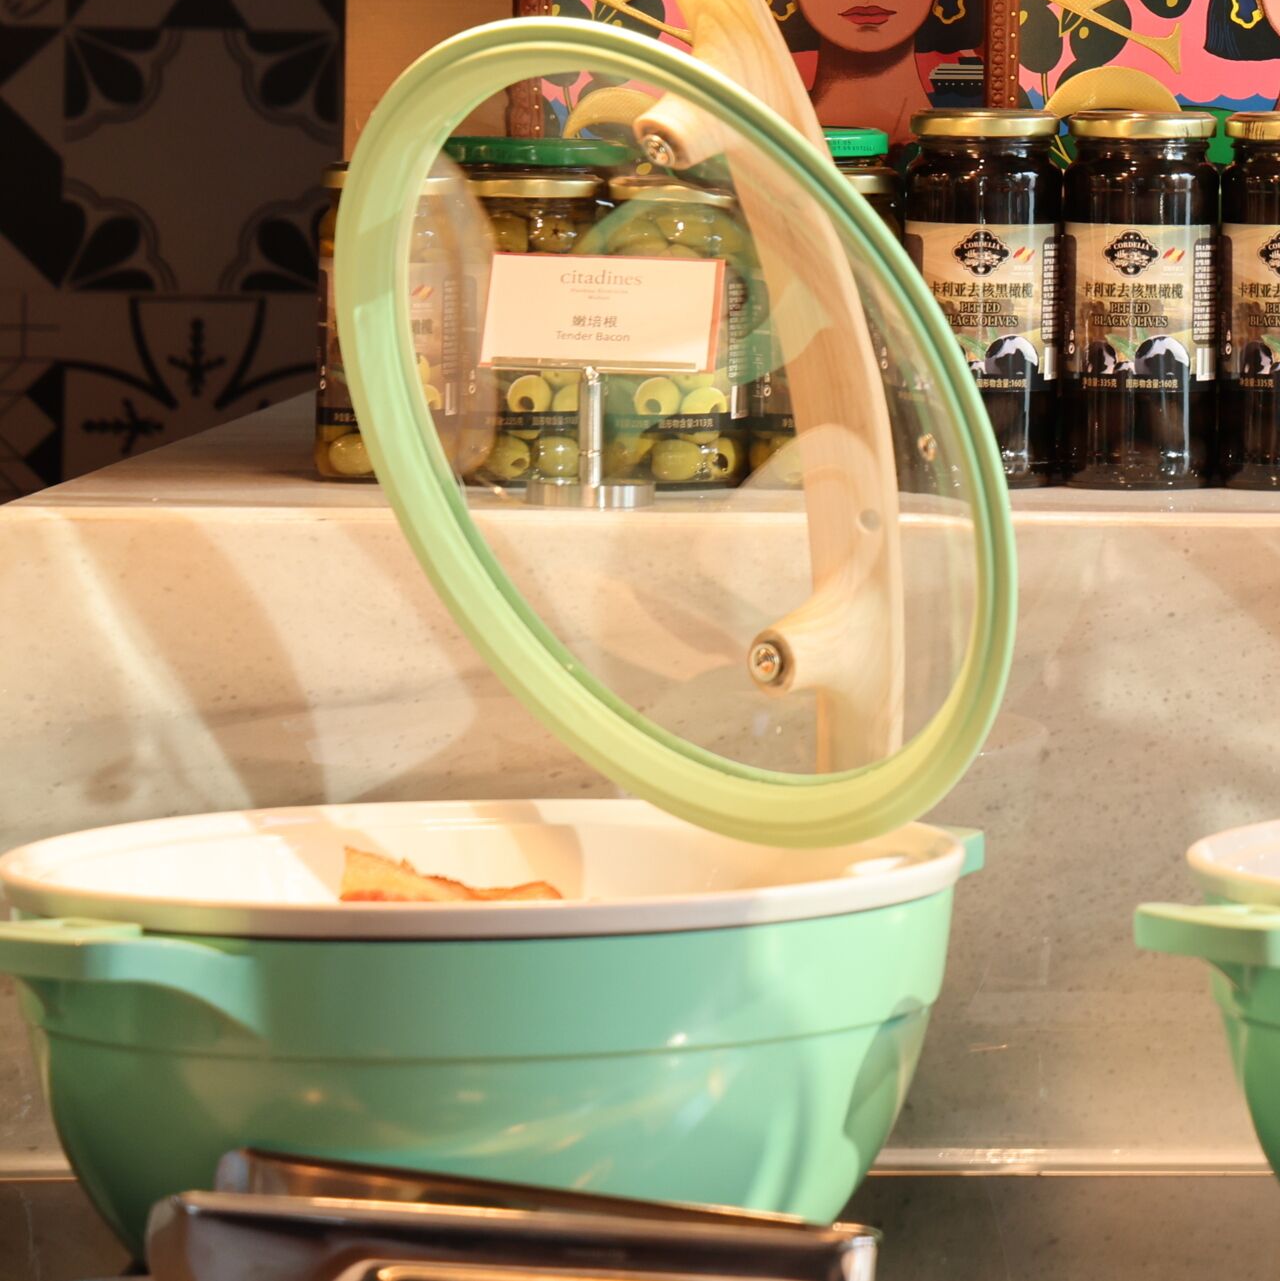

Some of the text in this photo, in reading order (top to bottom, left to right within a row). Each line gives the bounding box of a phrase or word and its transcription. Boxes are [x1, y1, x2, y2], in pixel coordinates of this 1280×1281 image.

[1113, 241, 1150, 251] CORDELIA
[560, 269, 642, 286] citadines
[931, 282, 1034, 299] 卡利亚去核黑橄榄
[1083, 282, 1184, 299] 卡利亚去核黑橄榄
[572, 315, 617, 328] 嫩培根
[947, 314, 1019, 328] LACK OLIVES
[1094, 314, 1168, 328] BLACK OLIVES
[556, 331, 630, 342] Tender Bacon
